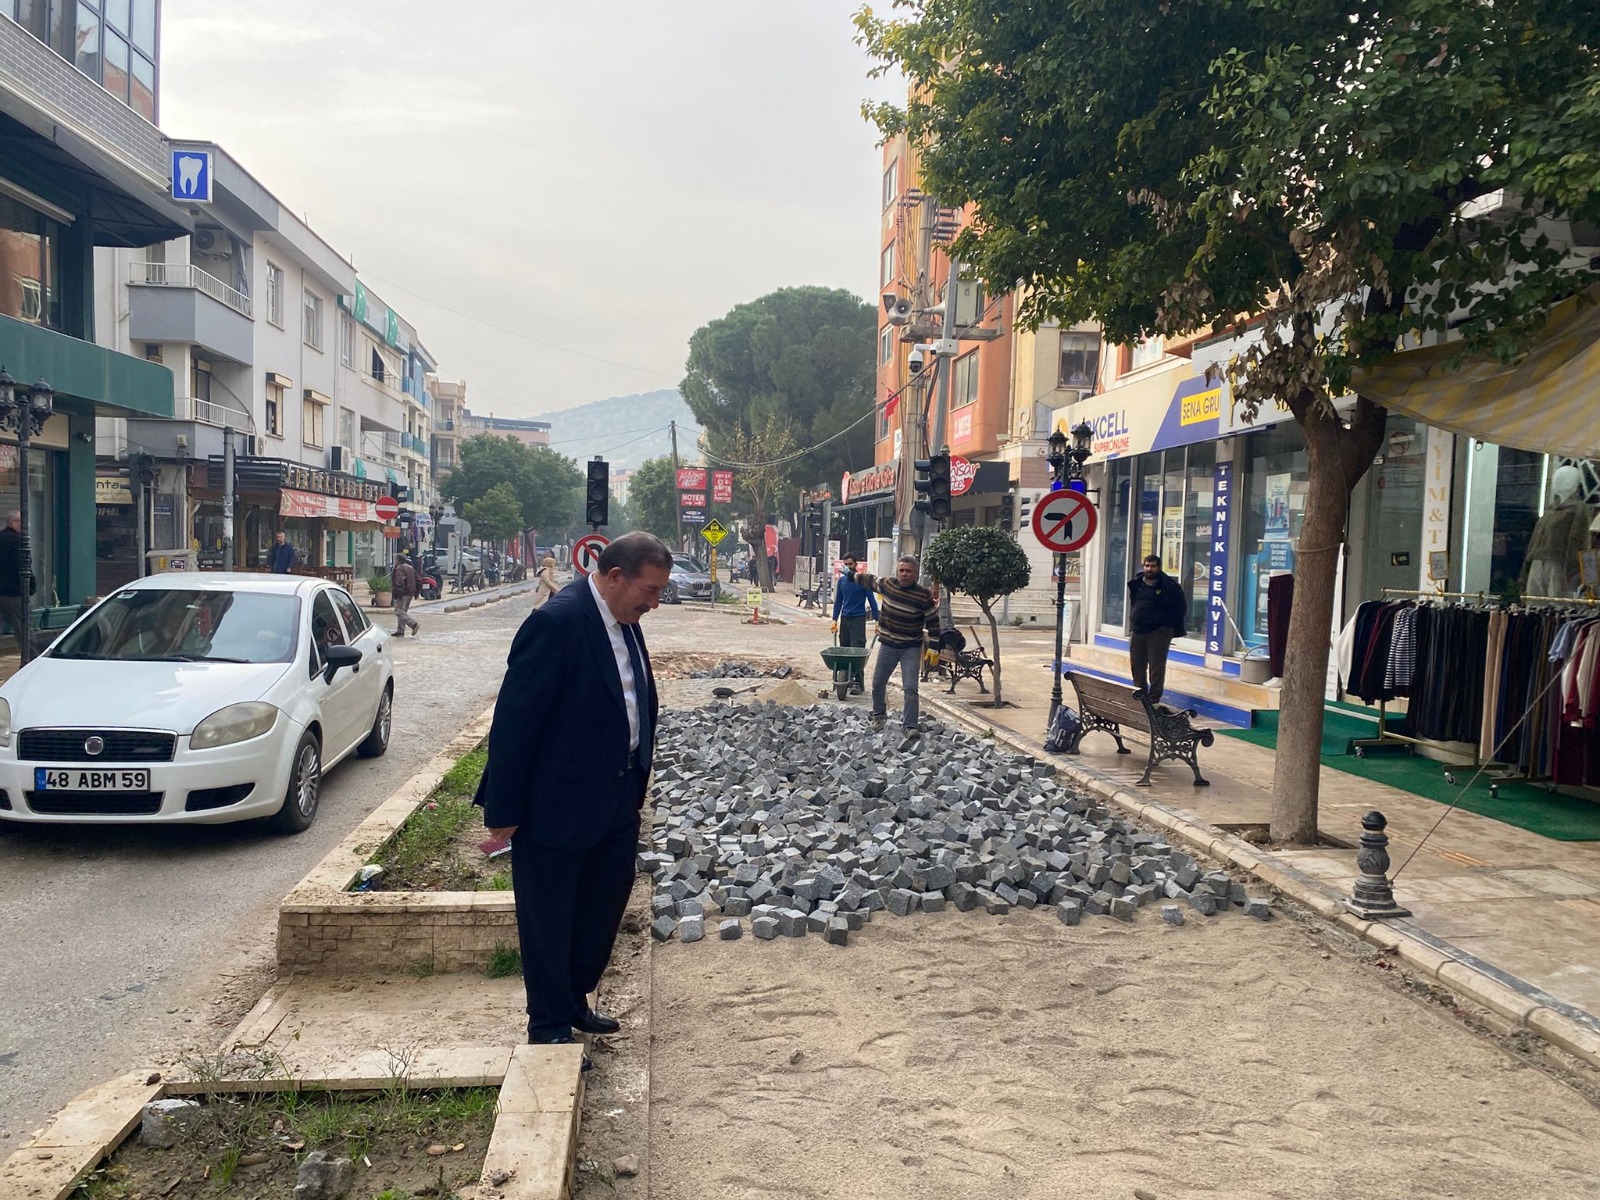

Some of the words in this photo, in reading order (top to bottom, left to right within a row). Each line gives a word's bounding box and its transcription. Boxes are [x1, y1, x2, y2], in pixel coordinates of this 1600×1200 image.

[1182, 401, 1201, 420] SENA
[1204, 396, 1219, 414] GRU
[1094, 437, 1130, 453] SUPERONLINE
[950, 460, 981, 476] hisar
[97, 480, 120, 489] nta
[1214, 465, 1229, 553] TEKNİK
[1209, 565, 1224, 652] SERVİS
[46, 772, 70, 788] 48
[78, 772, 116, 788] ABM
[122, 772, 146, 788] 59
